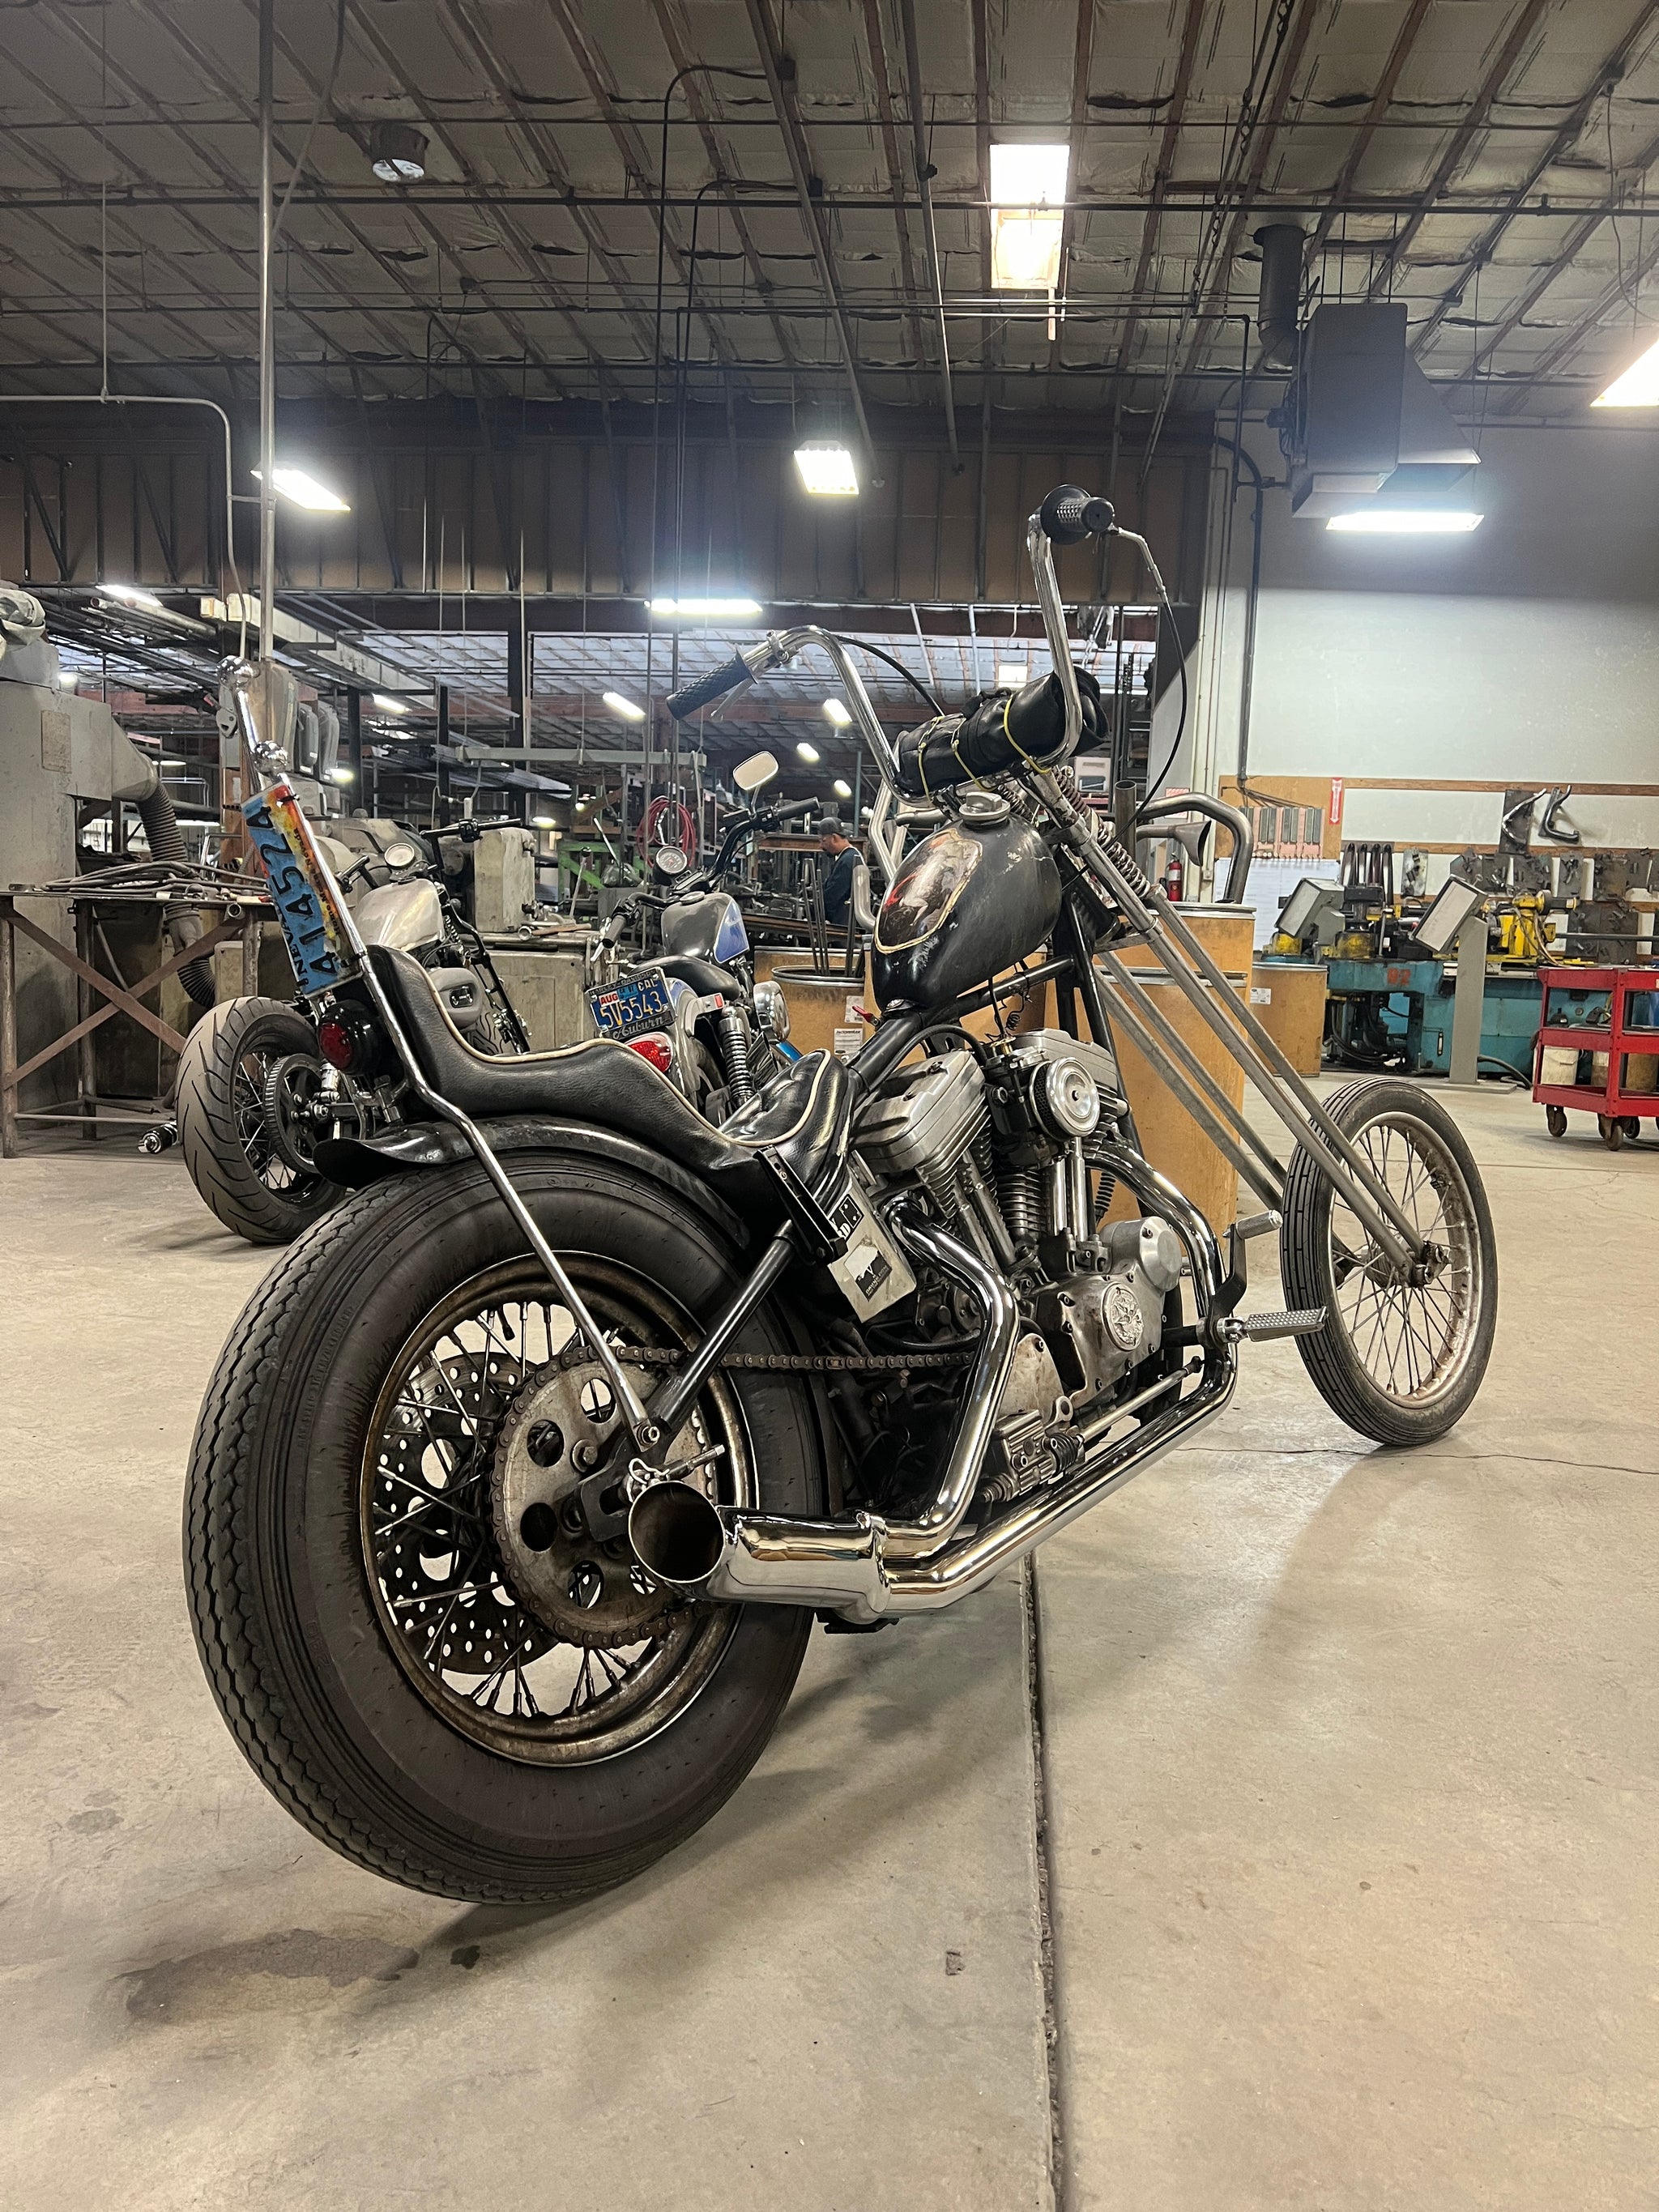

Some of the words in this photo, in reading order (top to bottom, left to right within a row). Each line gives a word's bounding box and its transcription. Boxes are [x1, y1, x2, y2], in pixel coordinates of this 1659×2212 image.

[293, 828, 313, 867] Nevada
[326, 905, 341, 936] Home
[638, 978, 658, 991] CAL
[600, 993, 618, 1005] AUG
[600, 991, 663, 1028] 5V5543
[612, 1016, 663, 1040] Auburn
